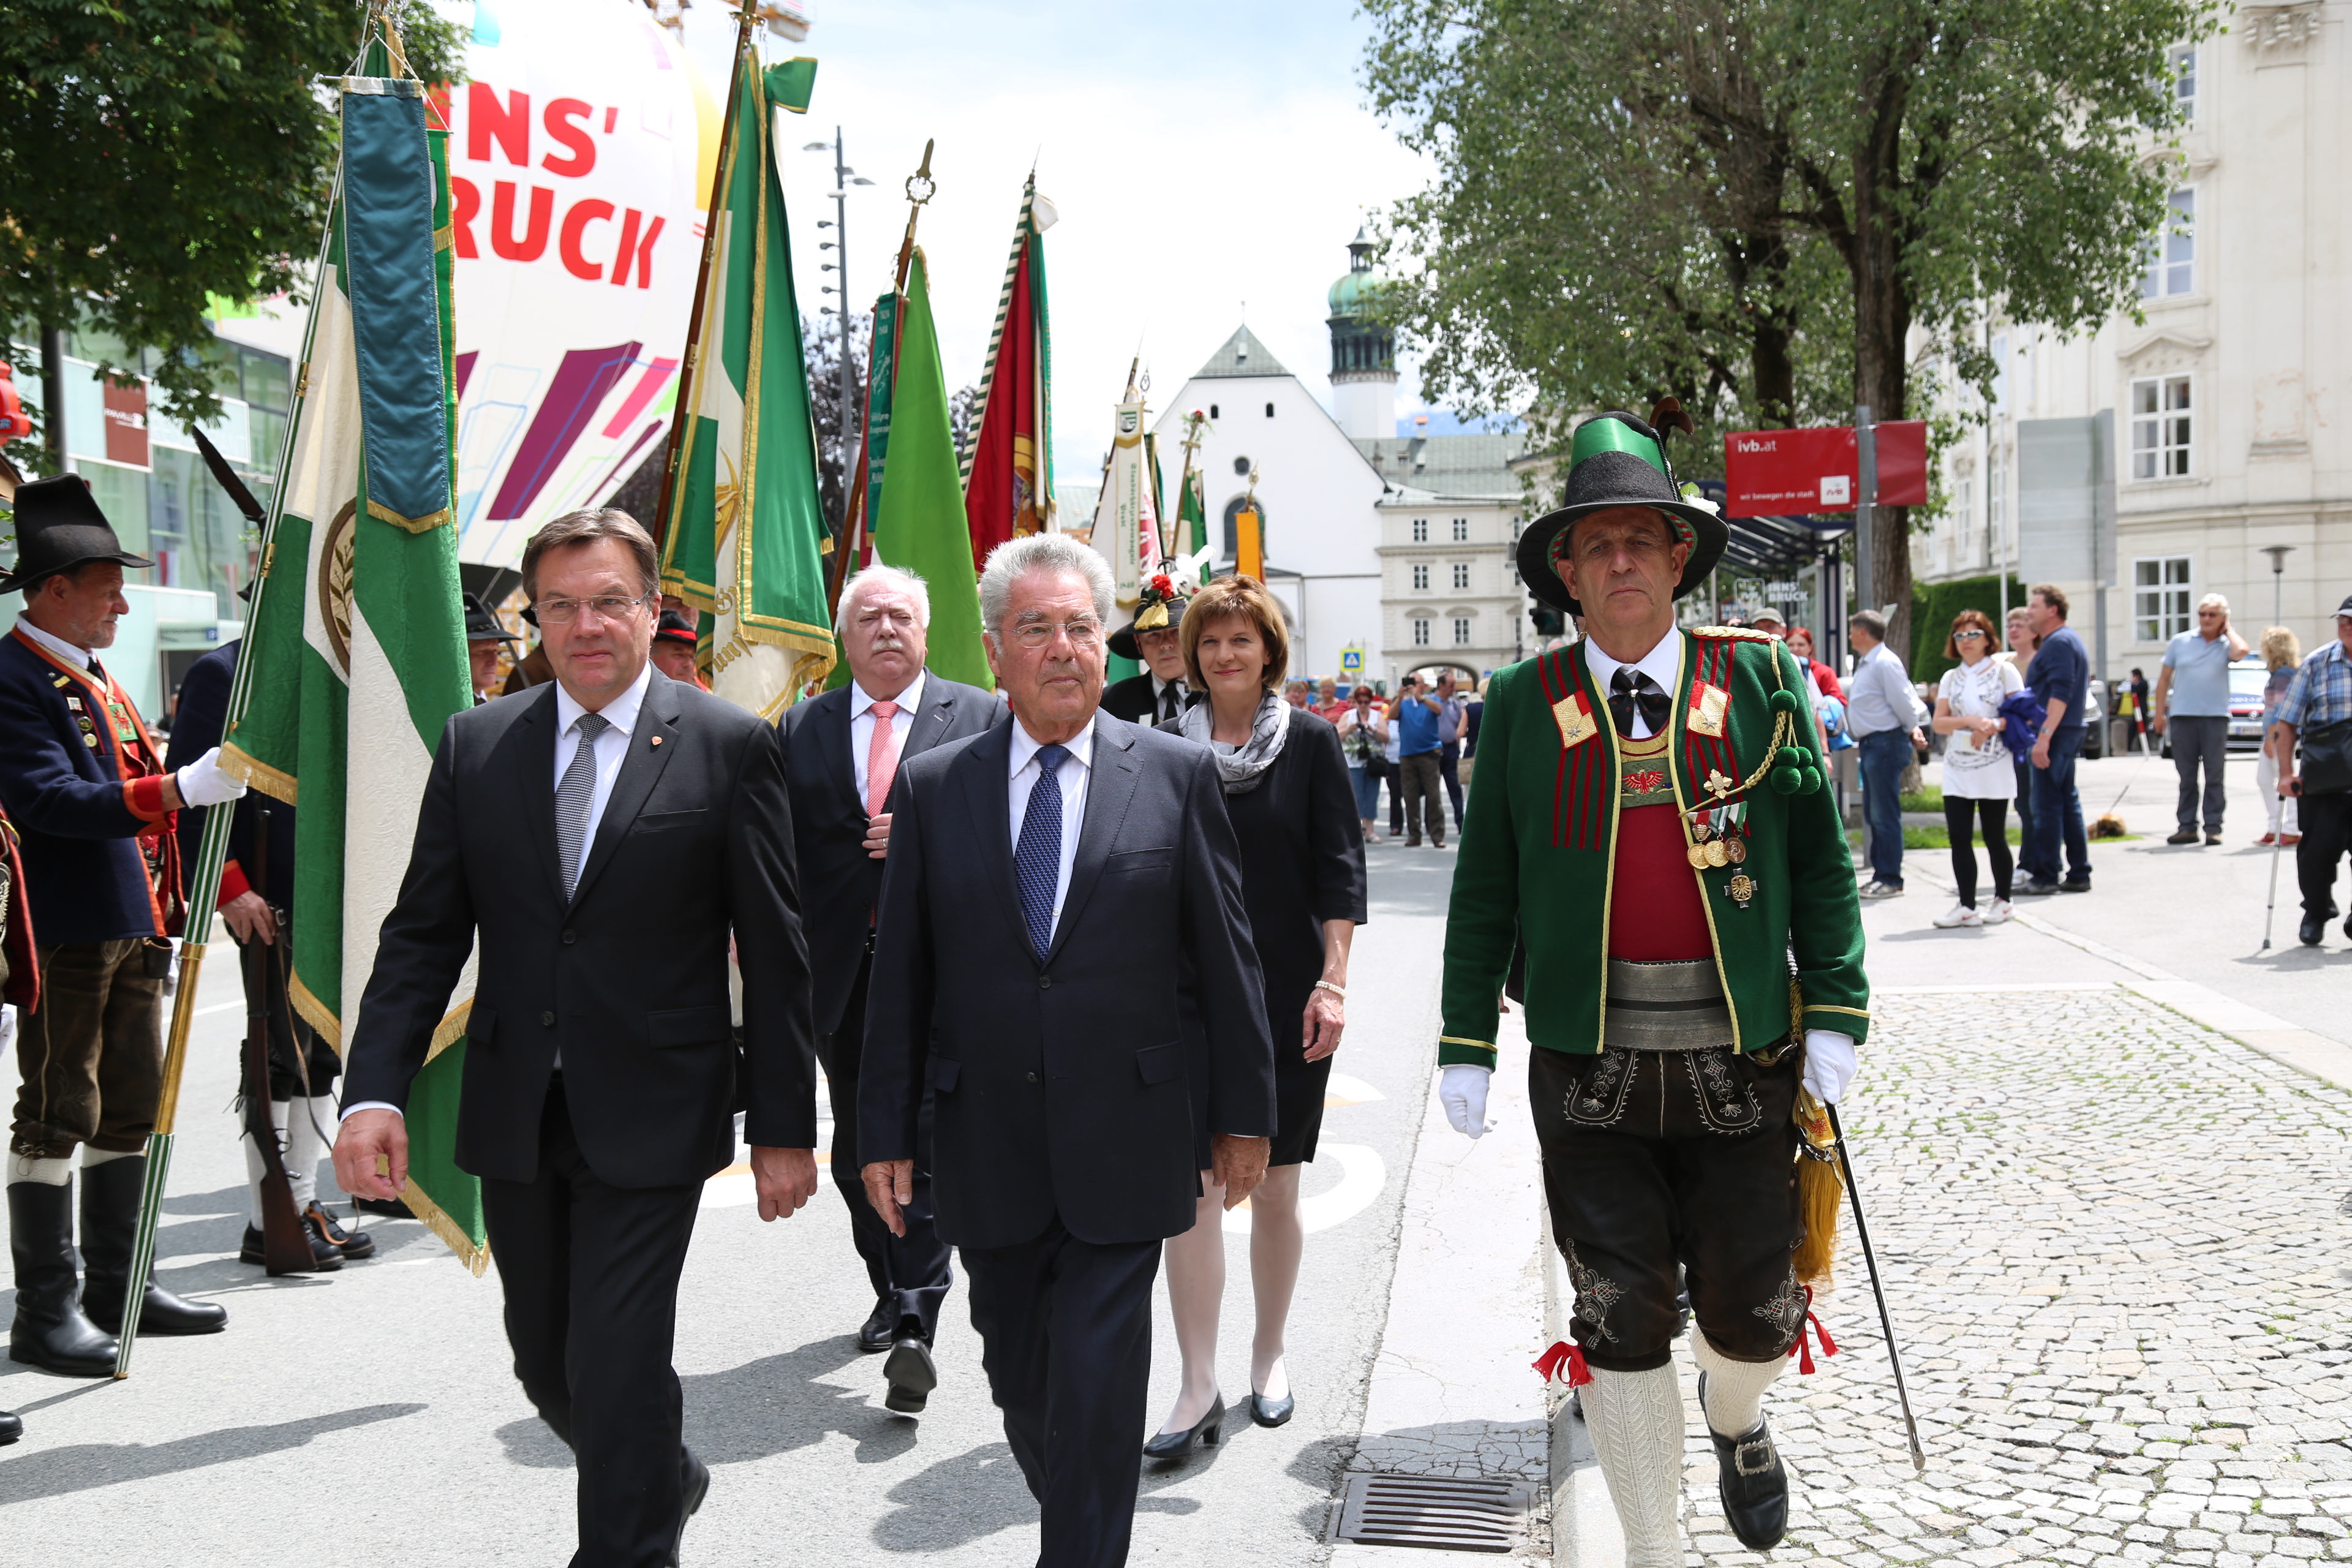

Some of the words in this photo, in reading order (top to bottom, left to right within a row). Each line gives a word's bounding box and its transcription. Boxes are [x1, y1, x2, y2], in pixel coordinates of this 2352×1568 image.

[1737, 439, 1777, 453] ivb.at
[1752, 492, 1784, 501] bewegen
[1785, 491, 1795, 499] die
